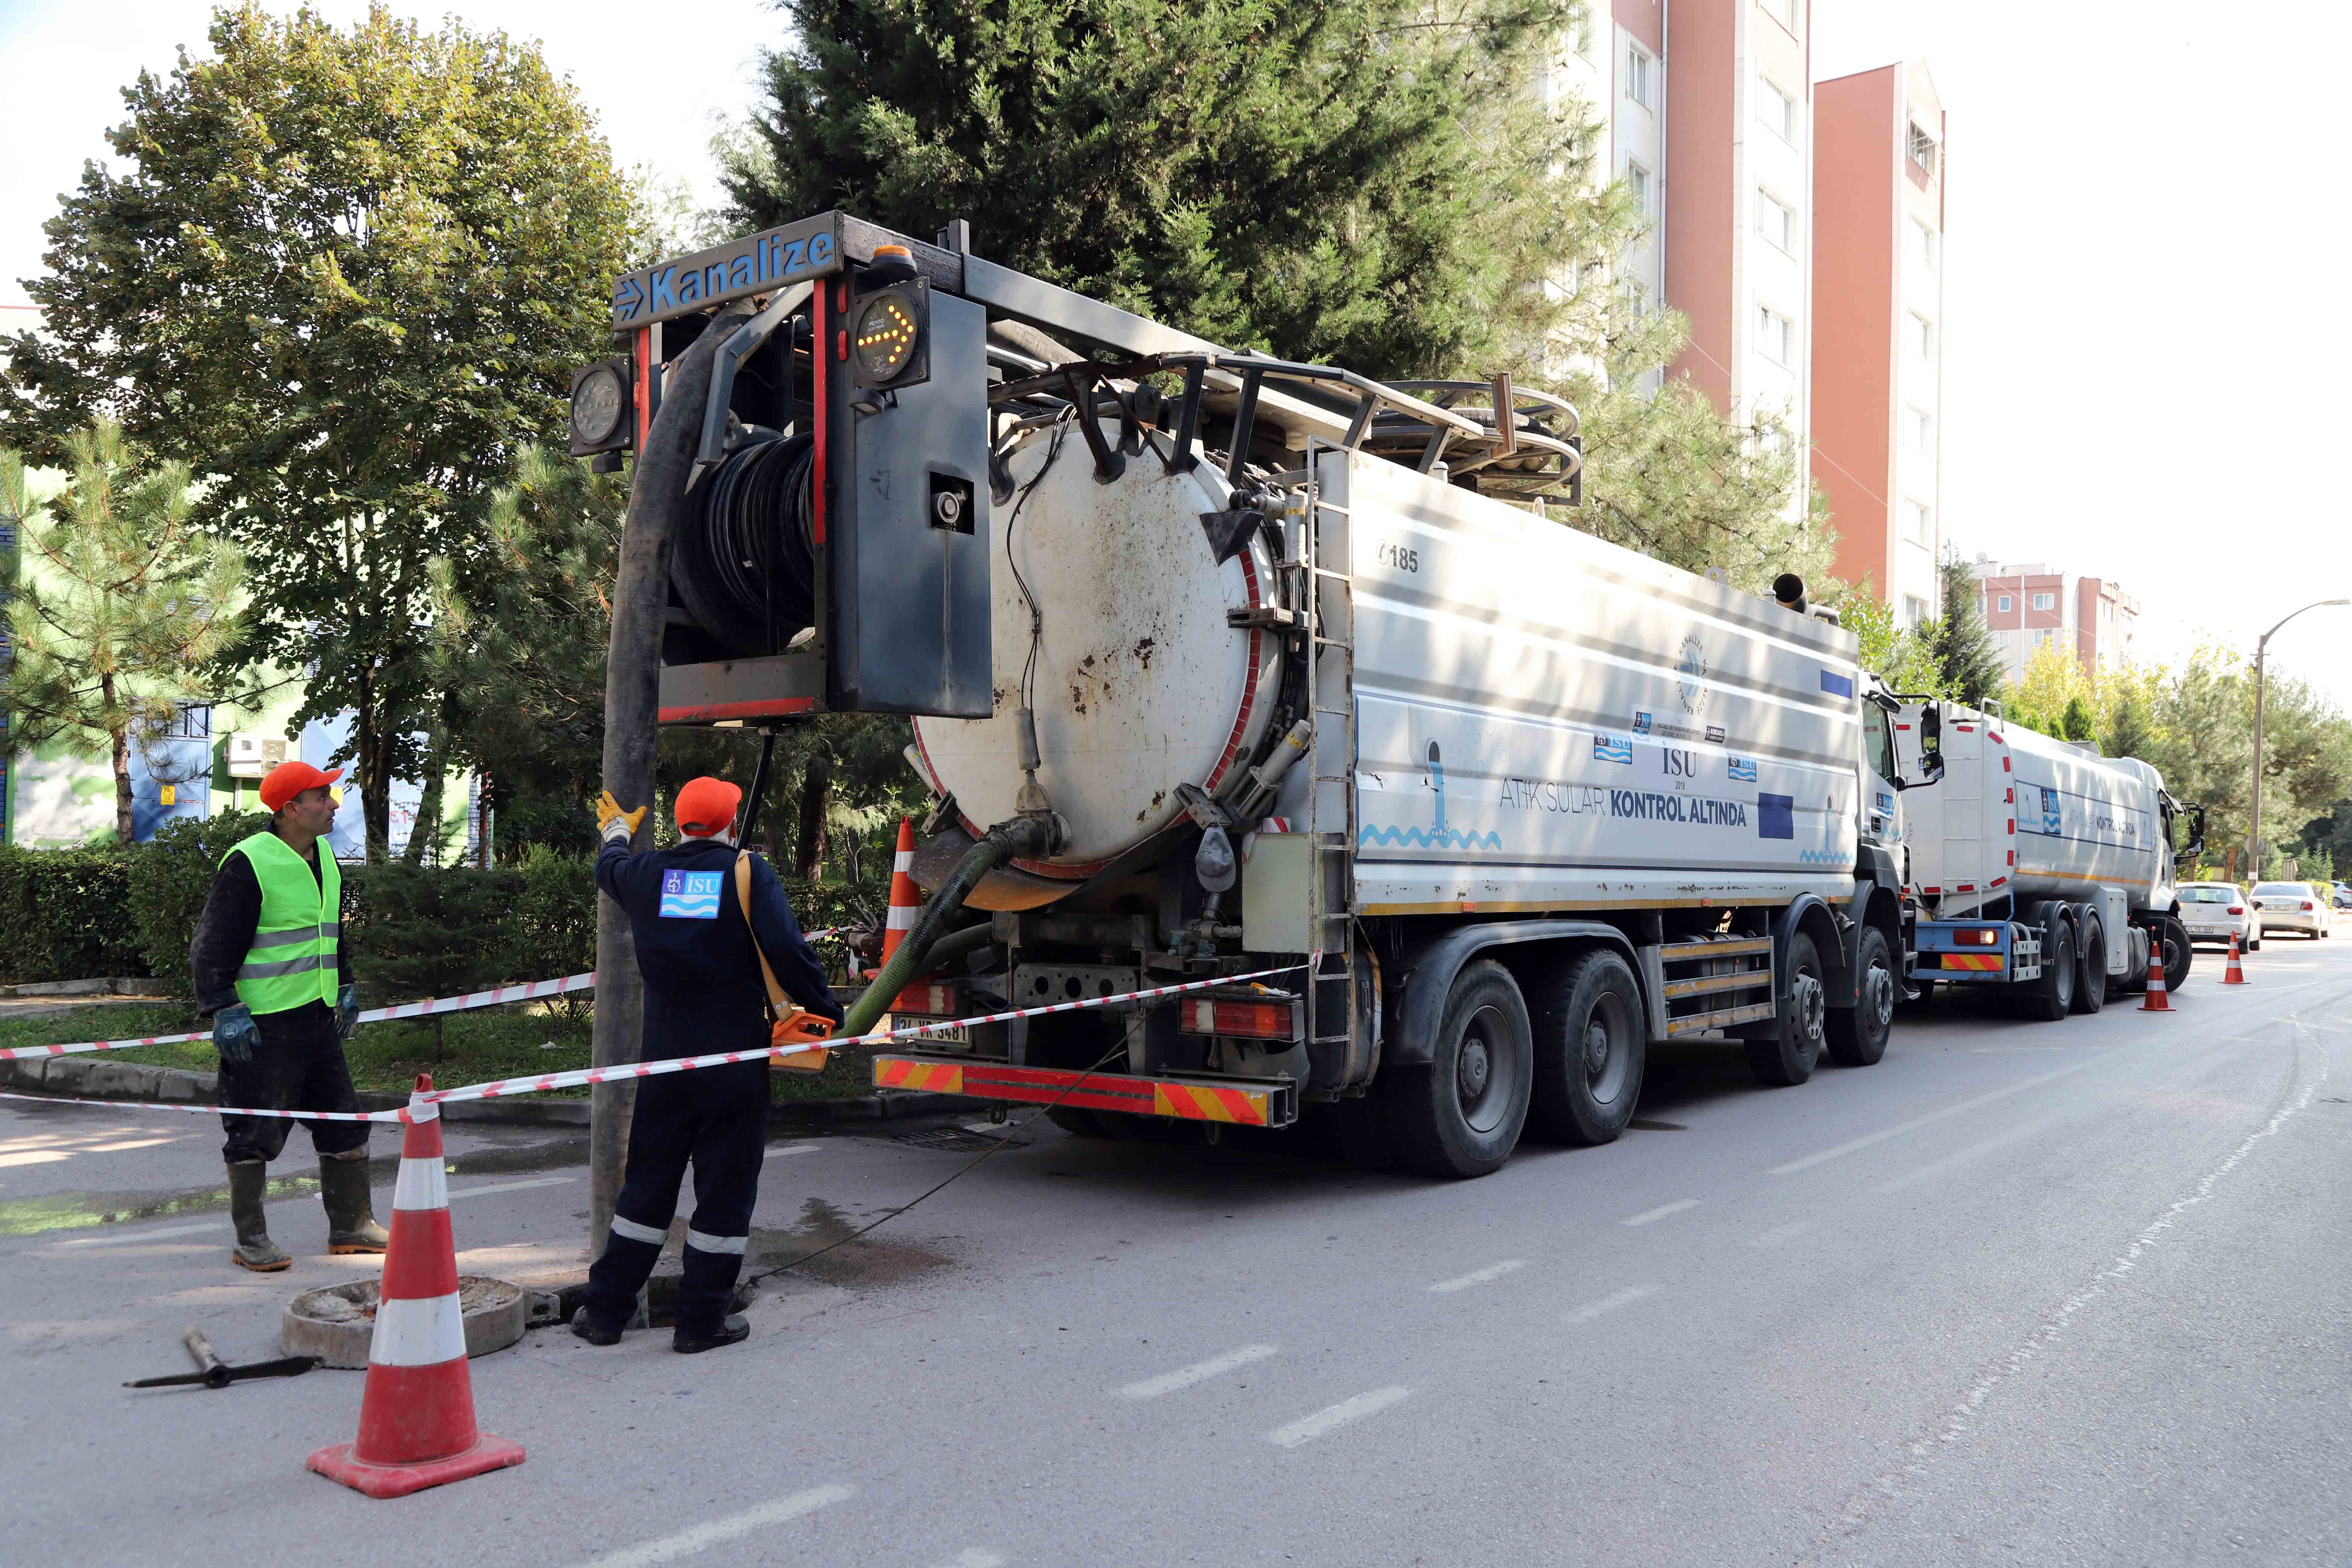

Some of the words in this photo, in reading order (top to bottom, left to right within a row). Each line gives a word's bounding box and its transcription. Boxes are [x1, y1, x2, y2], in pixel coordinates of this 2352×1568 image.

[650, 231, 834, 313] Kanalize
[1390, 545, 1418, 573] 185
[1661, 740, 1698, 778] İSU
[1500, 777, 1542, 811] ATIK
[1546, 782, 1605, 816] SULAR
[1610, 789, 1687, 823] KONTROL
[1689, 798, 1747, 827] ALTINDA
[1675, 781, 1685, 790] 2018
[687, 875, 721, 893] İSU
